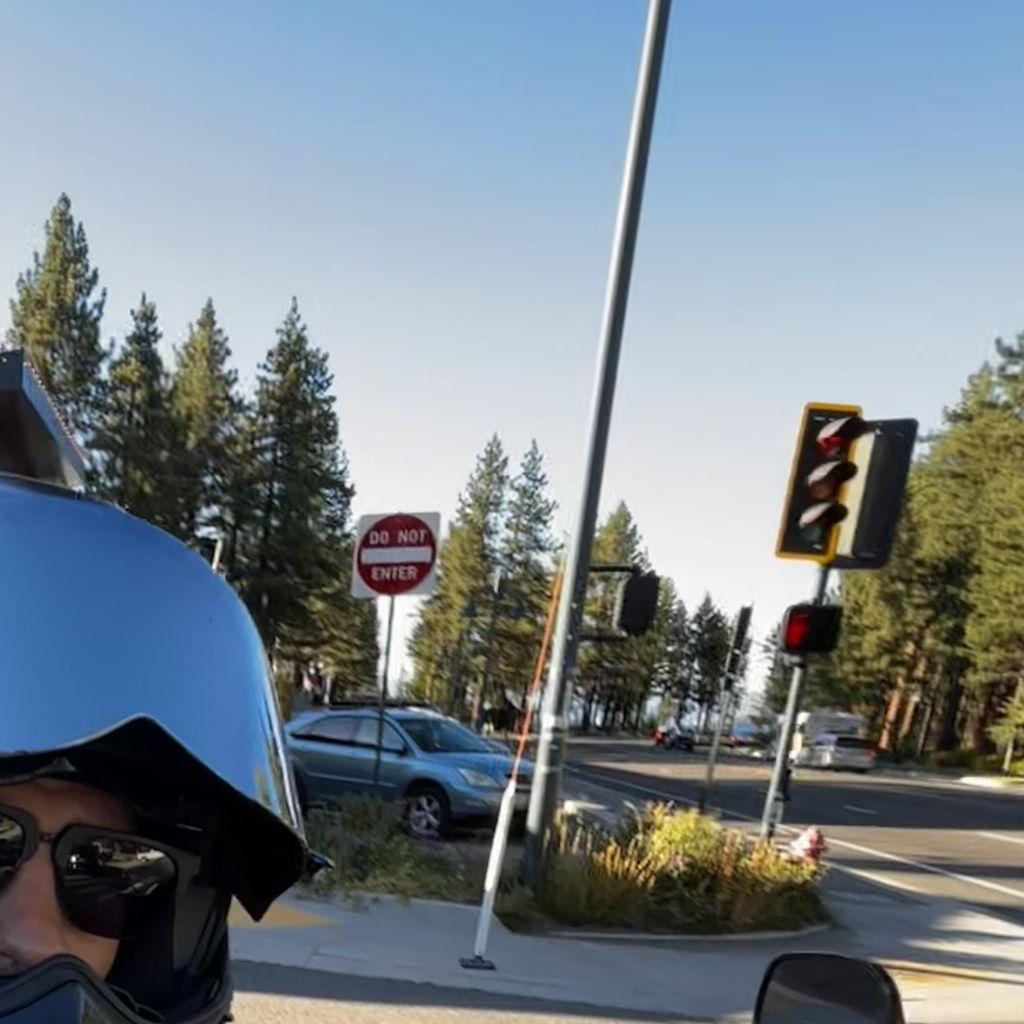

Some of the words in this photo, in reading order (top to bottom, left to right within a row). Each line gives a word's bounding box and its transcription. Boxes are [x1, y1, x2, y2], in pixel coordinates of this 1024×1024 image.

[369, 530, 390, 545] DO
[397, 529, 427, 544] NOT
[371, 566, 417, 581] ENTER
